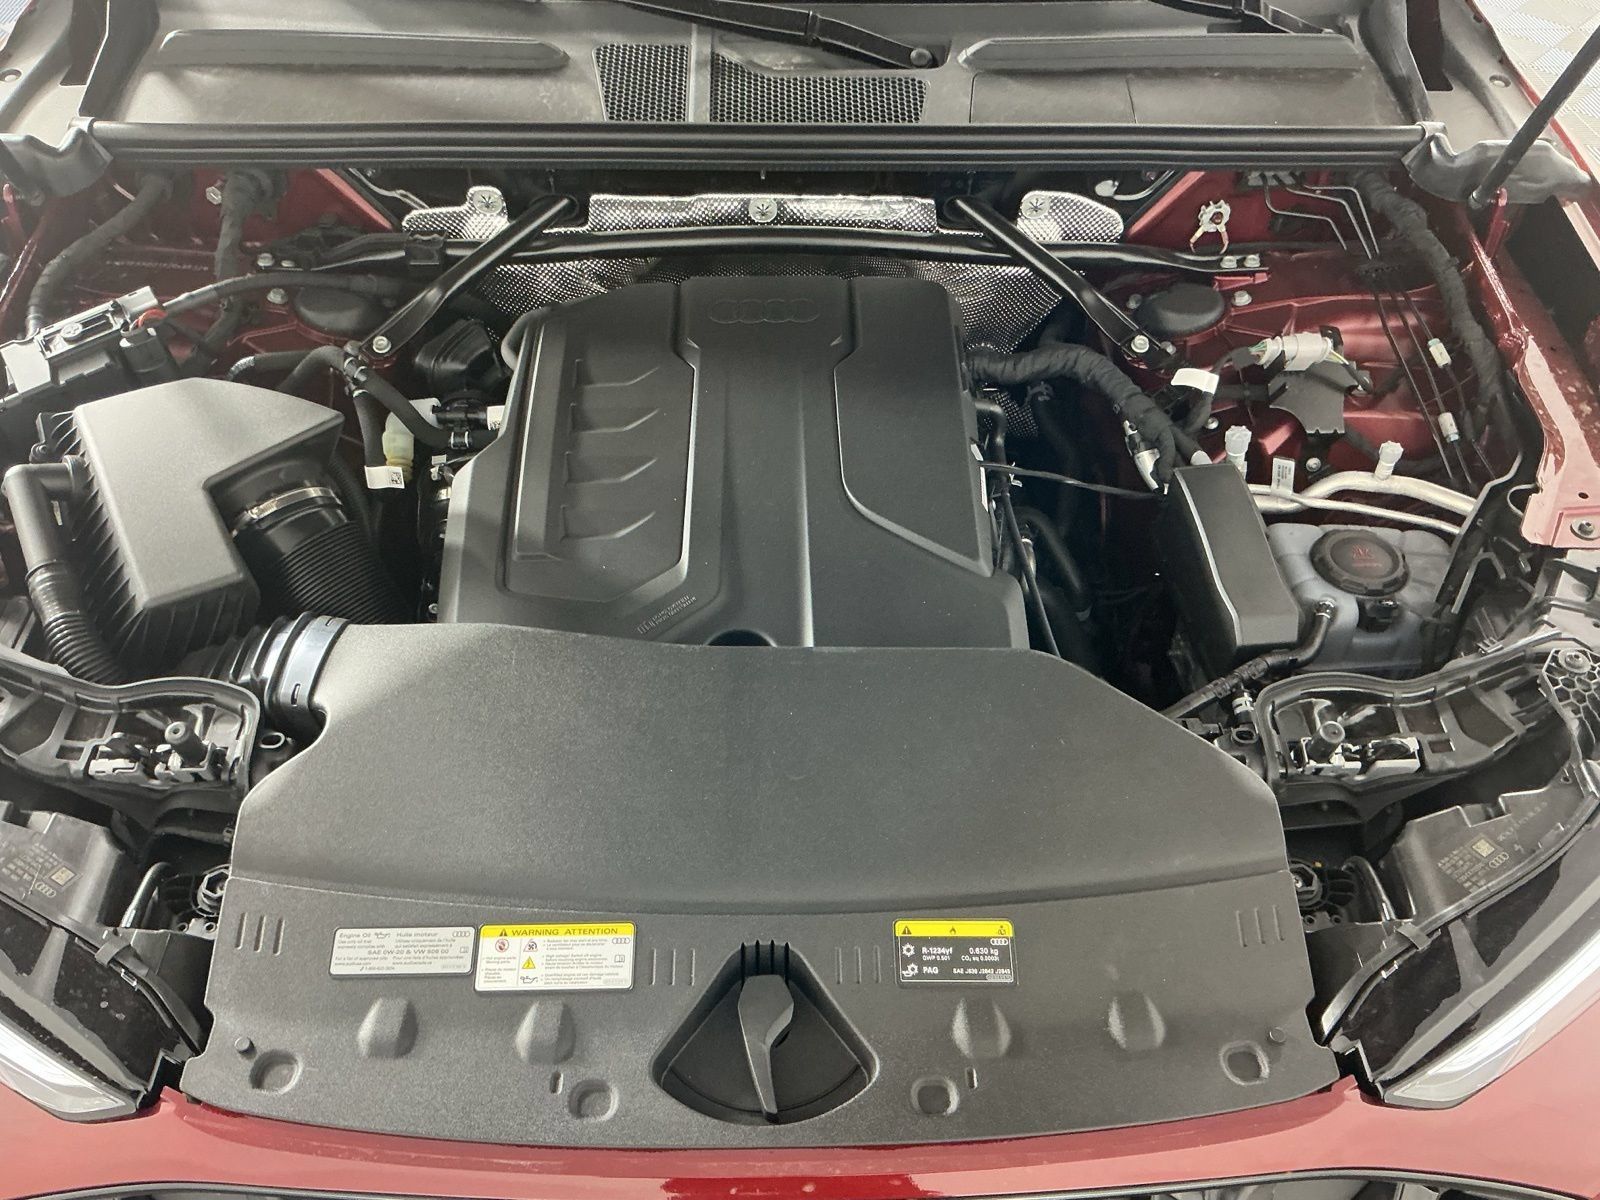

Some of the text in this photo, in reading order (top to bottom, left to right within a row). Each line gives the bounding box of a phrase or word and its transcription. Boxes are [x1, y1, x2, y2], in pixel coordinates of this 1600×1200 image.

[564, 928, 618, 936] ATTENTION
[922, 946, 952, 955] R-1234yf
[990, 948, 999, 956] kg
